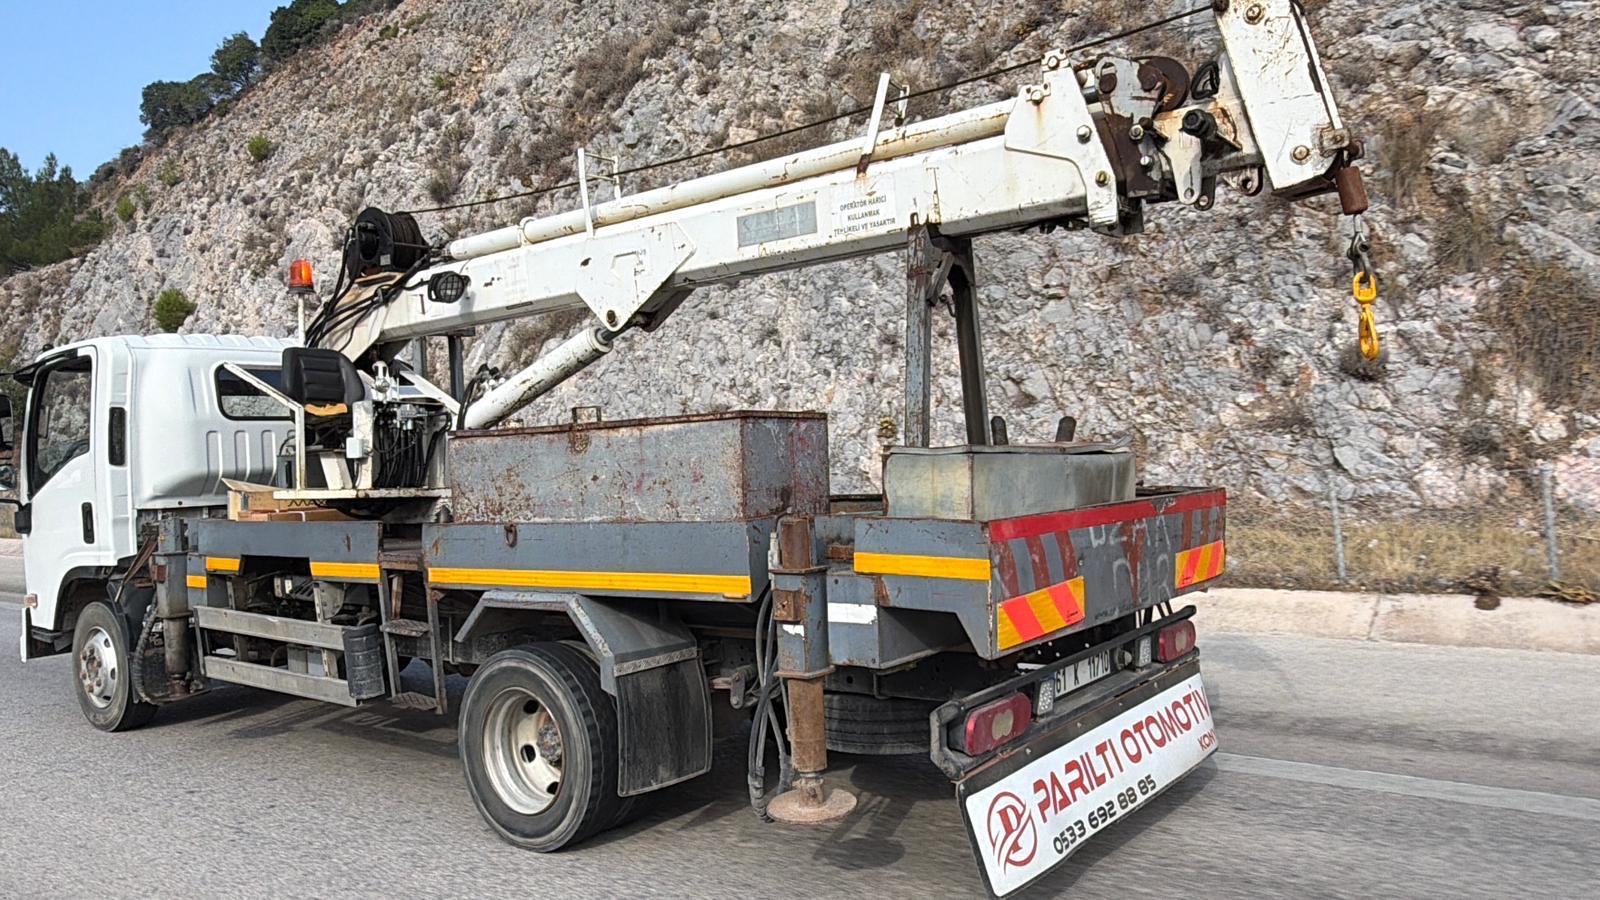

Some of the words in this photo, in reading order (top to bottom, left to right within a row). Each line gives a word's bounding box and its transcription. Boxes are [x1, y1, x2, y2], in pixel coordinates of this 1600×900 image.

[1055, 667, 1066, 694] 61
[1073, 662, 1081, 687] K
[1033, 738, 1124, 824] PARILTI
[1053, 819, 1086, 855] 0533
[1088, 800, 1117, 831] 692
[1119, 786, 1137, 811] 88
[1138, 774, 1157, 798] 85
